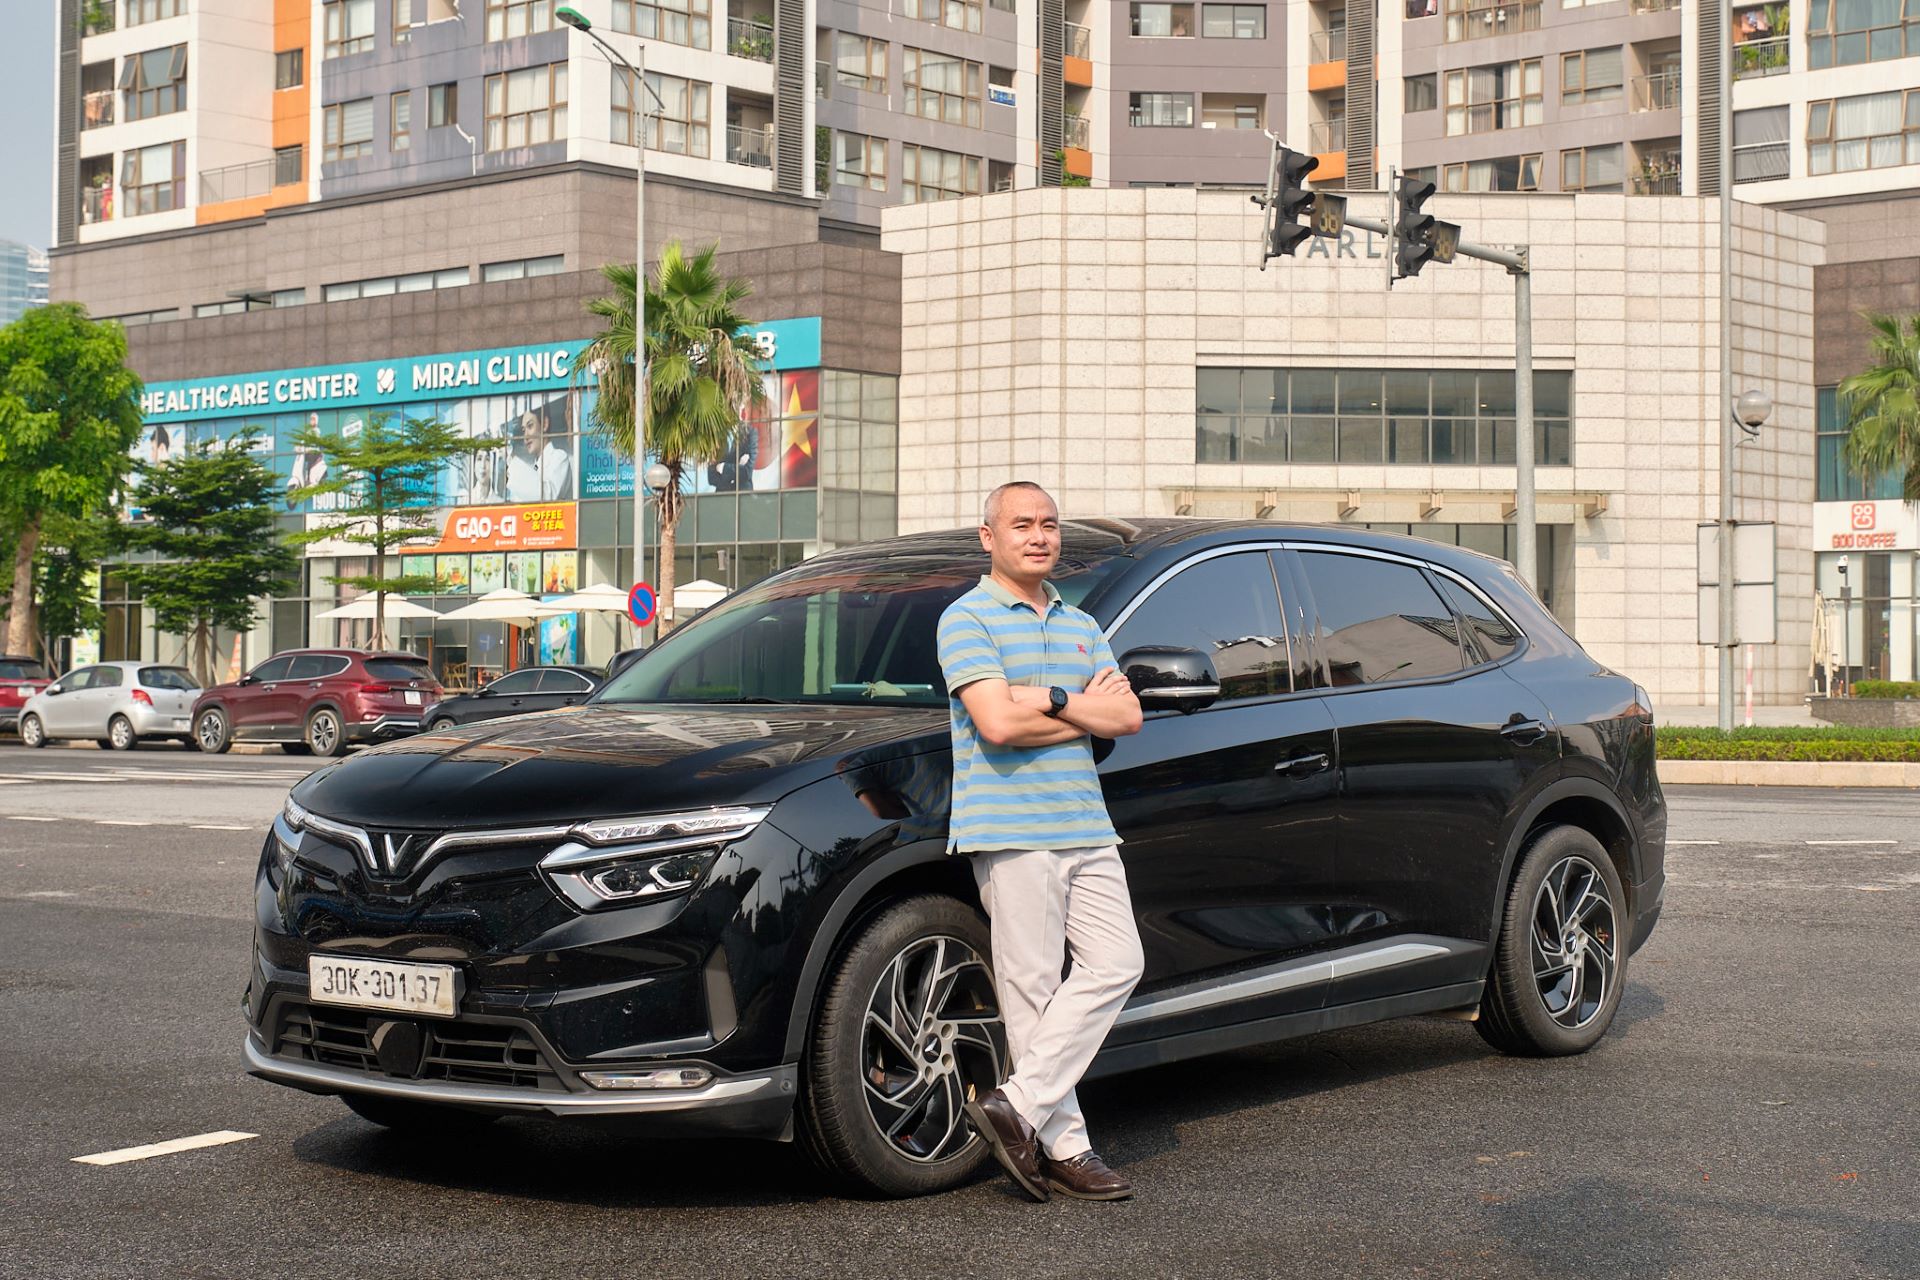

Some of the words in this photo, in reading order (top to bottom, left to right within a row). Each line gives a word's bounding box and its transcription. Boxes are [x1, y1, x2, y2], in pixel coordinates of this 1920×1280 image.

[140, 381, 270, 414] HEALTHCARE
[274, 373, 359, 402] CENTER
[412, 358, 480, 391] MIRAI
[486, 349, 570, 384] CLINIC
[523, 510, 563, 522] COFFEE
[532, 522, 542, 532] &
[544, 520, 566, 532] TEA
[1856, 532, 1897, 548] COFFEE
[322, 966, 440, 1004] 30K-301.37
